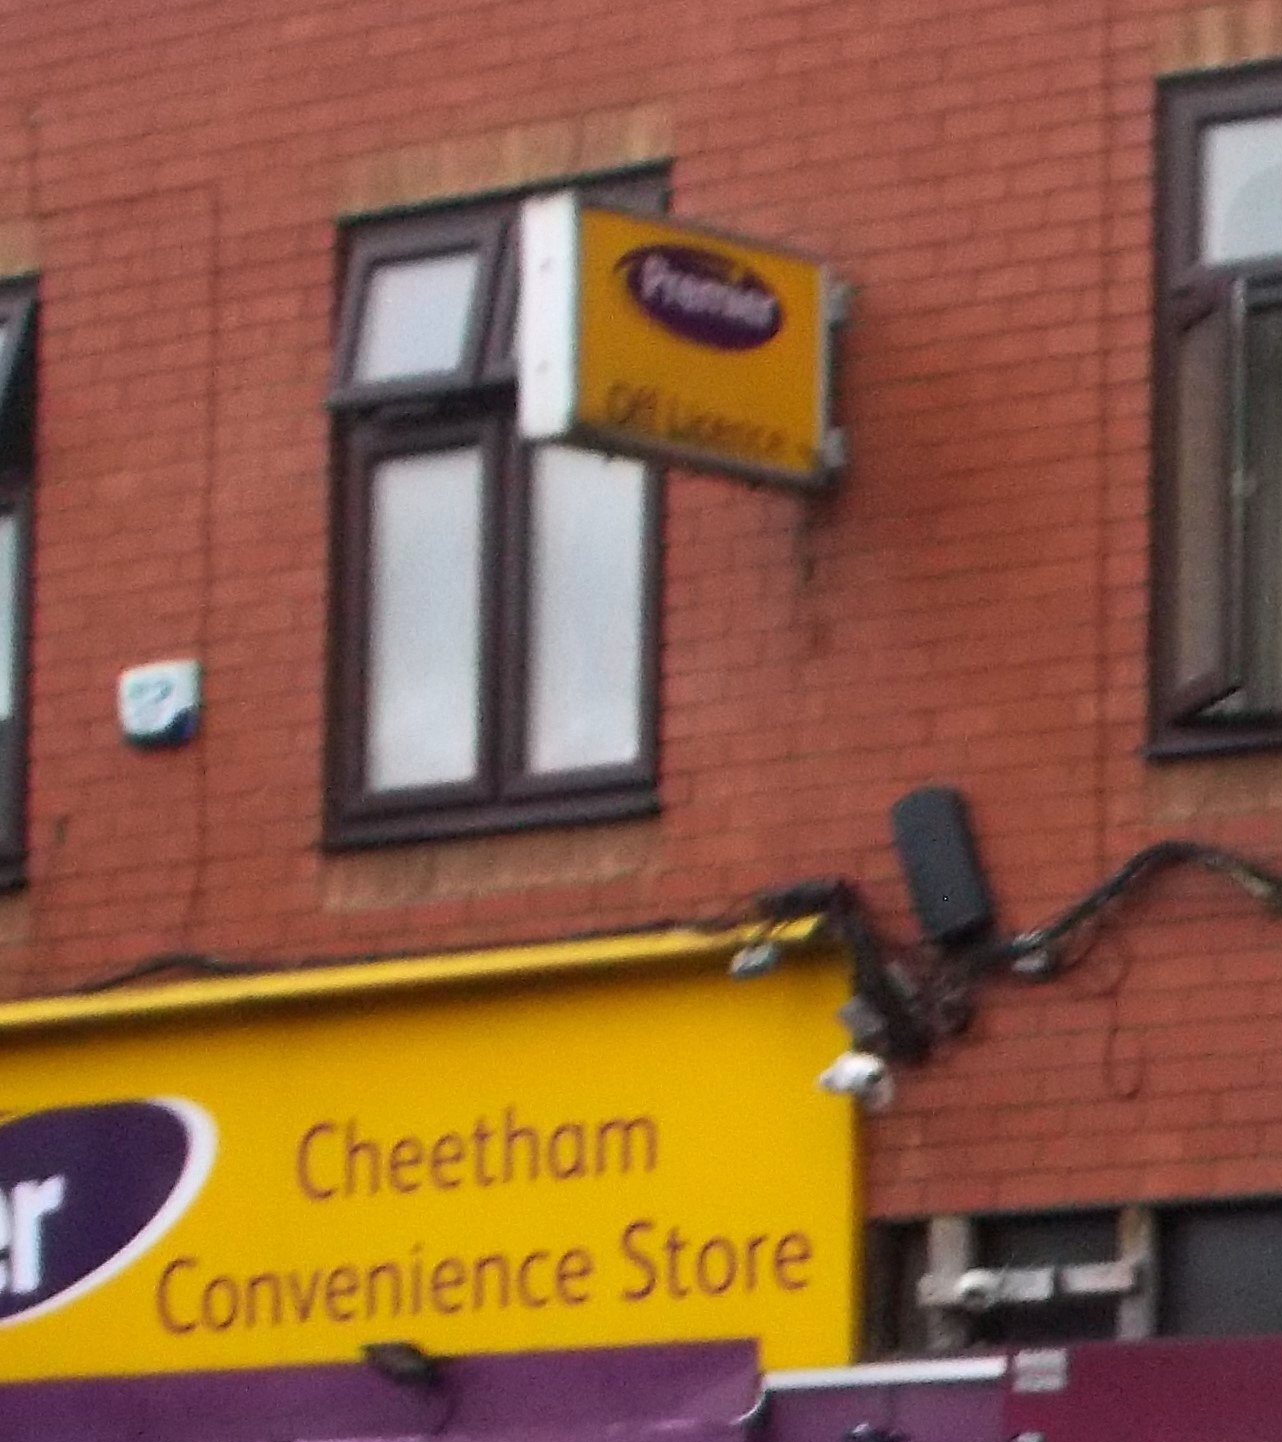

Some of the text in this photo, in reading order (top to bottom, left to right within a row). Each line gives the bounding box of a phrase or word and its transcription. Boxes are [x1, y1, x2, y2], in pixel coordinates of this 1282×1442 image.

[294, 1107, 660, 1204] Cheetham
[156, 1217, 815, 1337] Convenience Store
